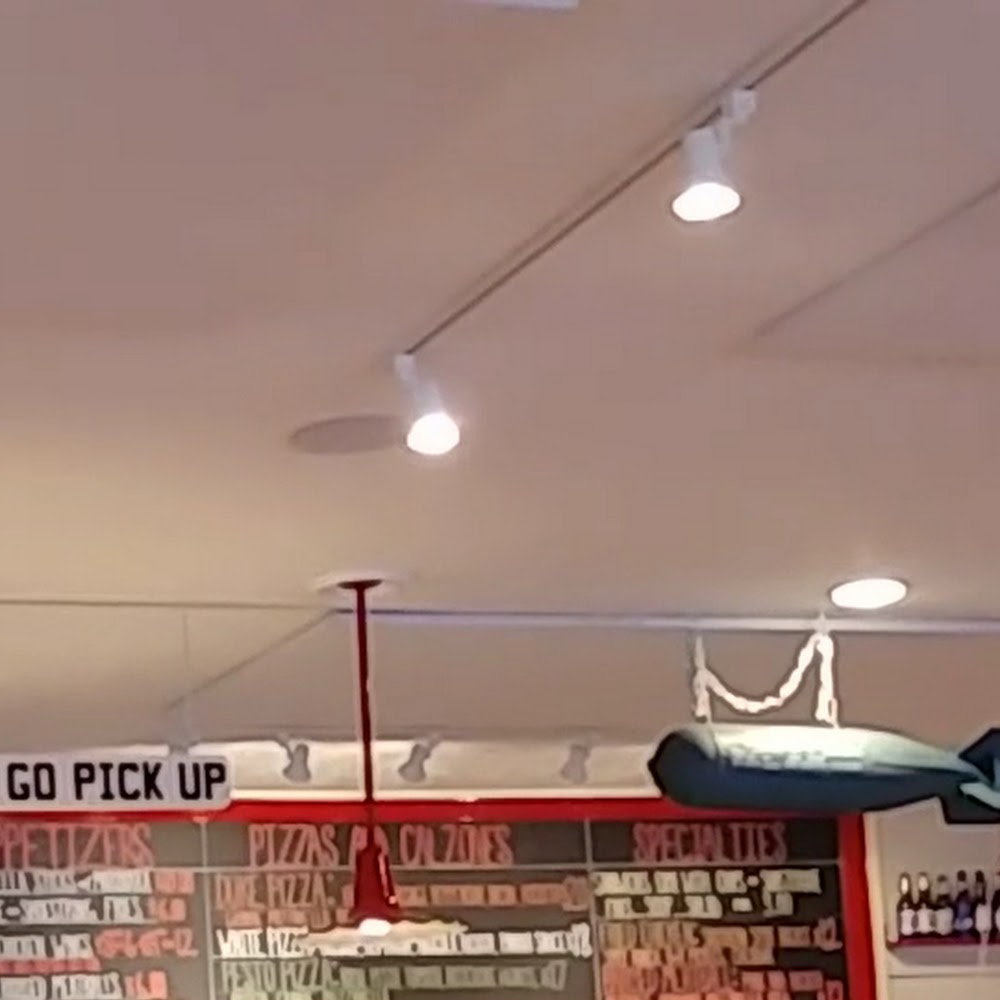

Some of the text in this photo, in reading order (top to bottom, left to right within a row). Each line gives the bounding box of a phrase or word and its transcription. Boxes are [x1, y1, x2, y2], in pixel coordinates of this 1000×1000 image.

[7, 762, 56, 801] GO
[74, 762, 164, 801] PICK
[178, 762, 227, 801] UP
[249, 823, 340, 868] PIZZAS
[632, 821, 789, 864] SPECIALTIES
